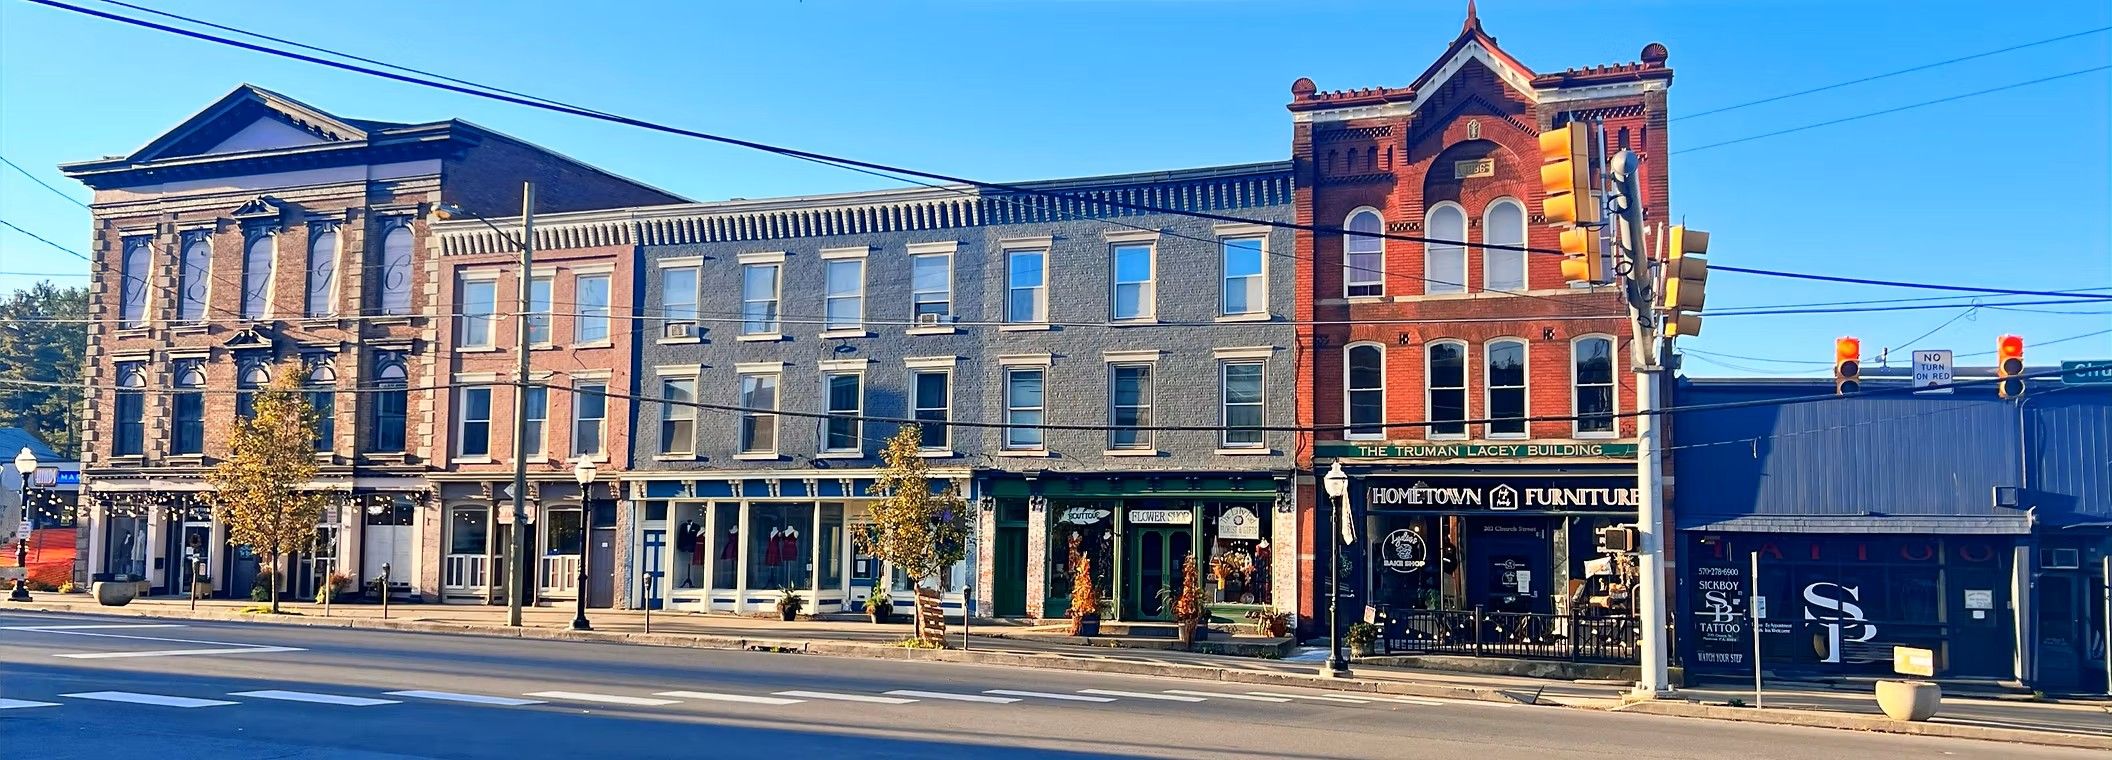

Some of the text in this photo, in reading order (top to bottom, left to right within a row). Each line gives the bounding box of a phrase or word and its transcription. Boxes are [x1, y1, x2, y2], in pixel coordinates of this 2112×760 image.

[1924, 353, 1941, 361] NO
[1916, 372, 1928, 380] ON
[1358, 444, 1603, 456] THE TRUMAN LACEY BUILDING
[1372, 487, 1482, 505] HOMETOWN
[1131, 511, 1190, 522] FLOWER SHOP
[1699, 581, 1739, 590] SICKBOY
[1700, 622, 1740, 633] TATTOO
[1697, 652, 1743, 663] WATCH YOUR STEP
